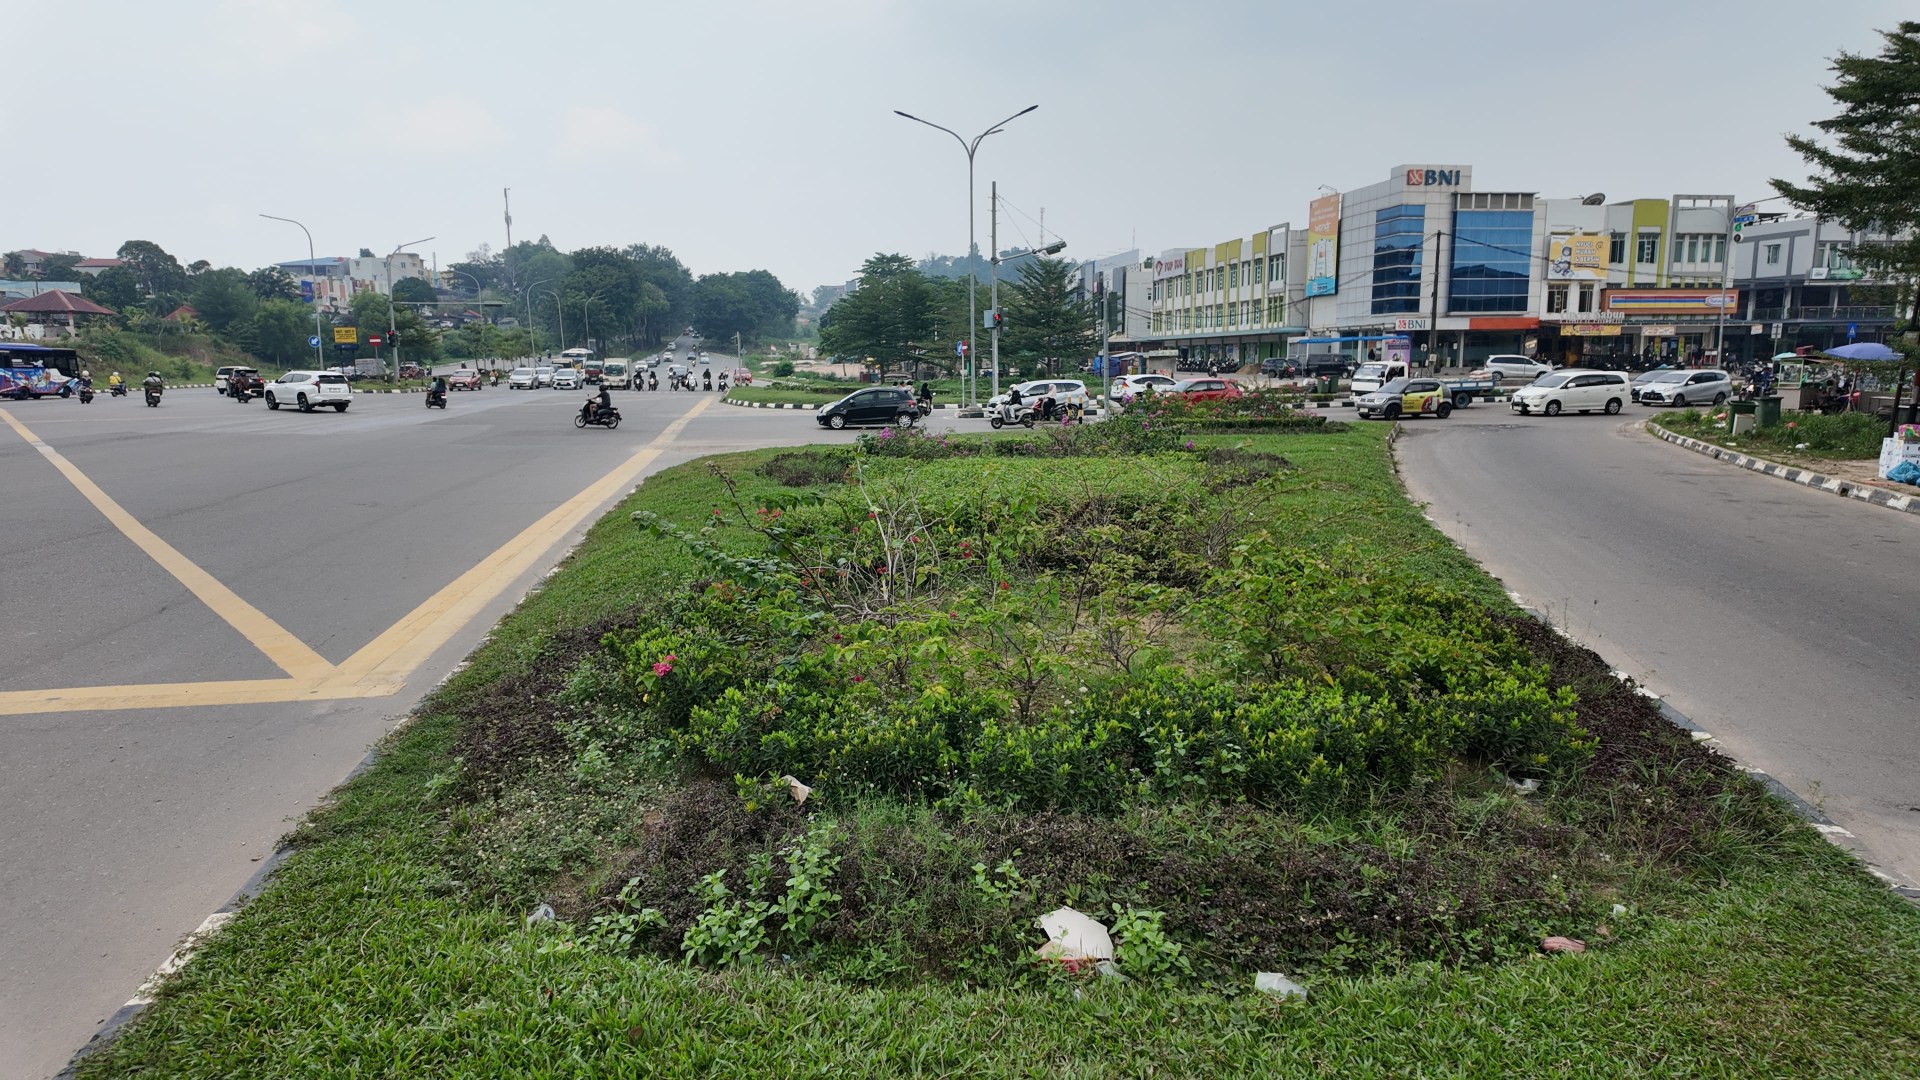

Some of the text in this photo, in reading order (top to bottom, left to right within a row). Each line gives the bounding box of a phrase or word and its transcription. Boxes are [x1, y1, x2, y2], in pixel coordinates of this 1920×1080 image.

[1424, 169, 1461, 186] BNI
[1594, 309, 1625, 319] Sabun
[1408, 319, 1426, 329] BNI
